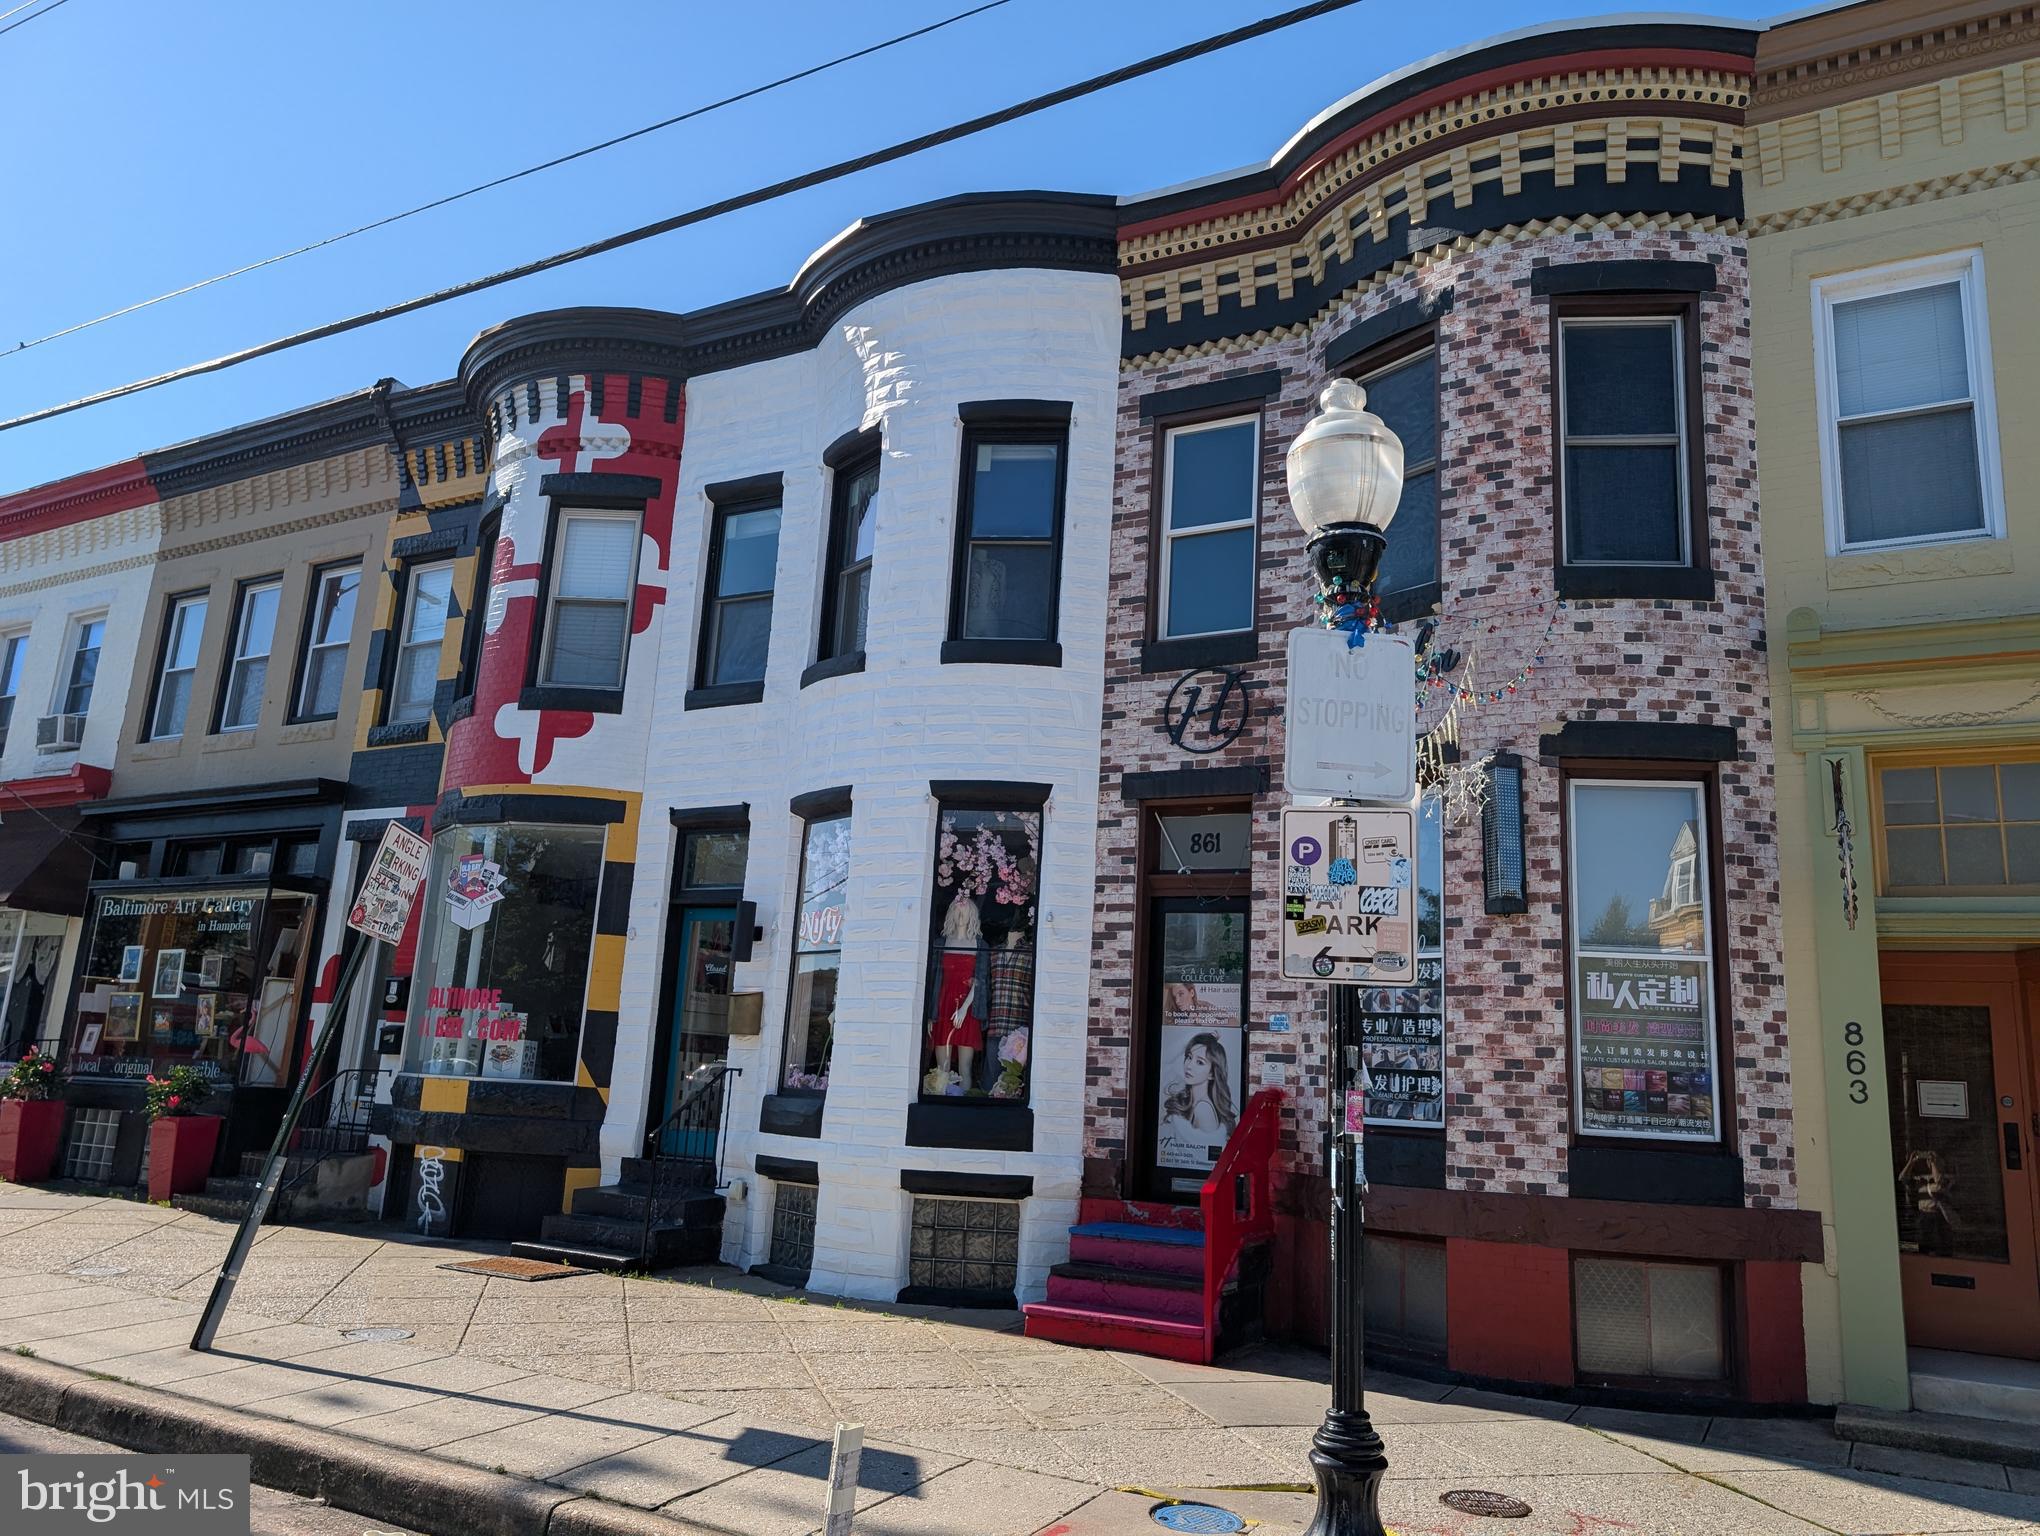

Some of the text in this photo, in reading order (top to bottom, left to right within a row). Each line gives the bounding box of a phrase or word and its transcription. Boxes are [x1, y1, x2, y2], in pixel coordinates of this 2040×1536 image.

[1334, 652, 1368, 680] NO
[1297, 697, 1405, 733] STOPPING
[392, 834, 423, 860] ANGLE
[1190, 833, 1222, 854] 861
[1298, 843, 1314, 859] P
[391, 856, 420, 881] RKING
[102, 897, 256, 917] Baltimore Art Gallery
[197, 919, 251, 933] in Hampden
[799, 905, 843, 944] Nifty
[1297, 919, 1325, 931] SPASM
[1312, 914, 1382, 936] ARK
[705, 963, 728, 973] Closed
[1181, 974, 1225, 982] COLLECTIVE
[427, 986, 503, 1011] ALTIMORE
[1223, 986, 1240, 994] salon
[1586, 972, 1699, 1010] 私人定制
[434, 1016, 465, 1038] BOX
[1361, 1018, 1432, 1036] 专业 造型
[78, 1057, 101, 1072] local
[114, 1058, 154, 1078] original
[1844, 1021, 1869, 1105] 863
[1401, 1076, 1432, 1094] 护理
